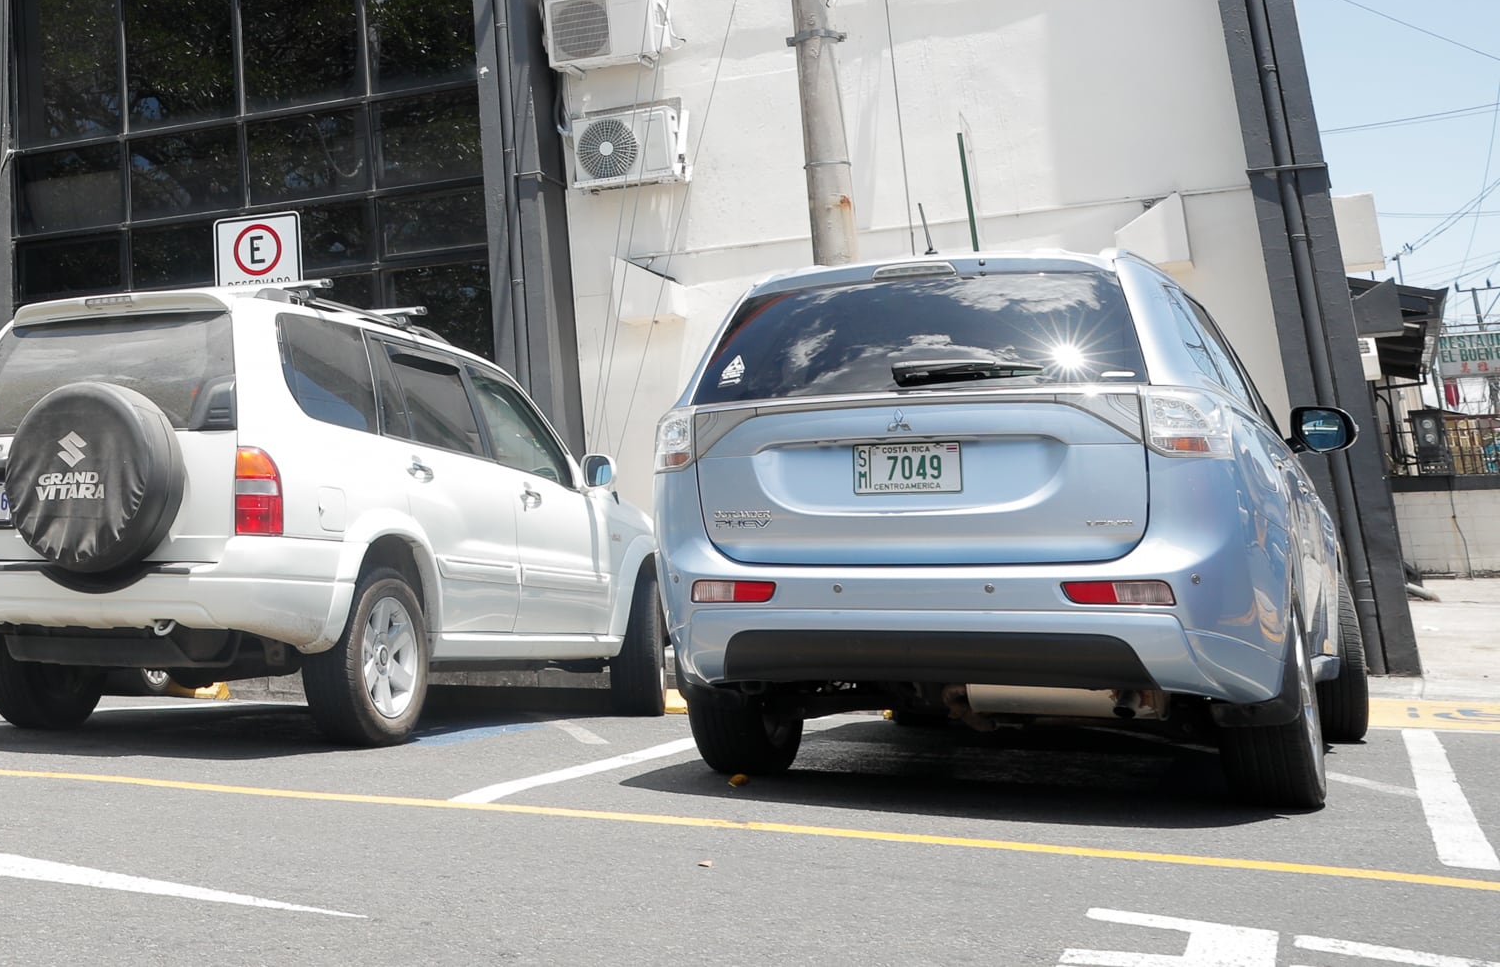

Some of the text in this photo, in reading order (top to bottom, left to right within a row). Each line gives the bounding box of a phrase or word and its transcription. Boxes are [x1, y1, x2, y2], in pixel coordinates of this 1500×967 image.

[250, 236, 265, 264] E
[1440, 350, 1457, 363] EL
[882, 445, 930, 454] COSTA RICA
[887, 454, 942, 481] 7049
[38, 471, 99, 486] GRAND
[35, 483, 105, 501] VITARA
[874, 482, 941, 491] CENTROAMERICA
